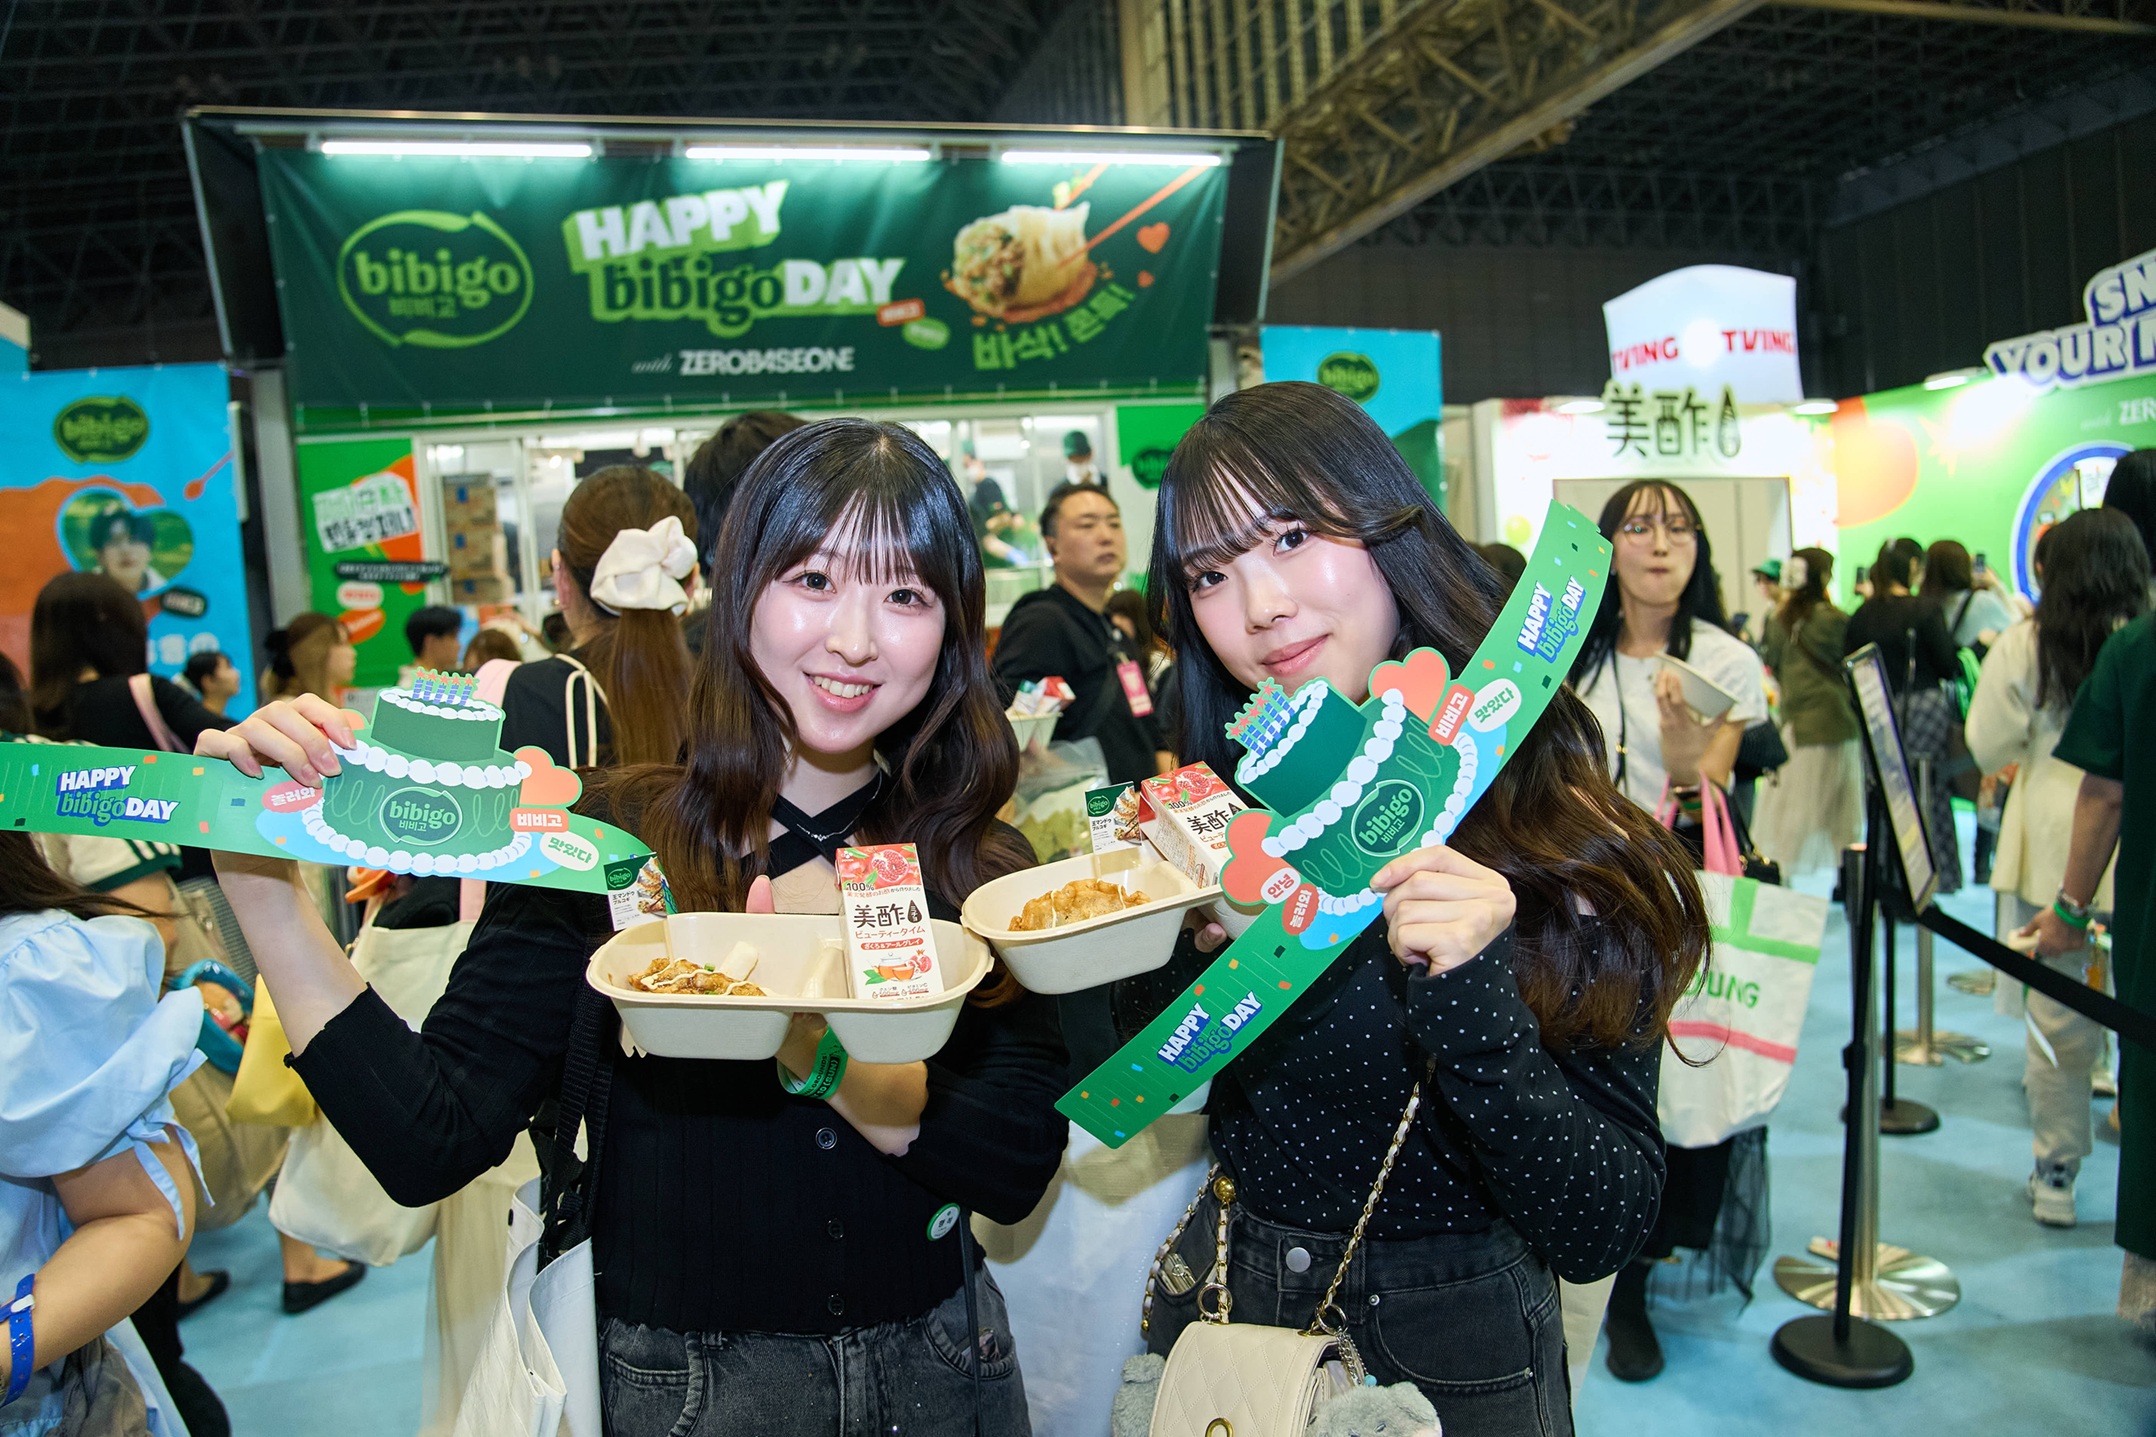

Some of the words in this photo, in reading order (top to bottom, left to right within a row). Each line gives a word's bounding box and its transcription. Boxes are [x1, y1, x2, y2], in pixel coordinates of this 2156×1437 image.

[574, 179, 790, 262] HAPPY
[355, 247, 520, 310] bibigo
[1997, 324, 2128, 383] YOUR
[1606, 386, 1709, 458] 美酢
[1517, 580, 1552, 651] HAPPY
[1435, 692, 1469, 739] 비비고
[1474, 687, 1515, 723] 맛있다
[60, 765, 137, 792] HAPPY
[390, 800, 457, 830] bibigo
[398, 819, 428, 833] 비비고
[516, 813, 563, 828] 비비고
[1186, 809, 1232, 835] 美酢
[1358, 788, 1413, 847] bibigo
[1380, 817, 1406, 844] 비비고
[547, 836, 593, 864] 맛있다
[846, 882, 875, 892] 100%
[1267, 873, 1295, 899] 안녕
[853, 902, 906, 929] 美酢
[1290, 889, 1313, 928] 놀러와
[855, 925, 926, 940] ビューティータイム
[1158, 1001, 1211, 1063] HAPPY
[823, 1059, 840, 1087] (SUN)
